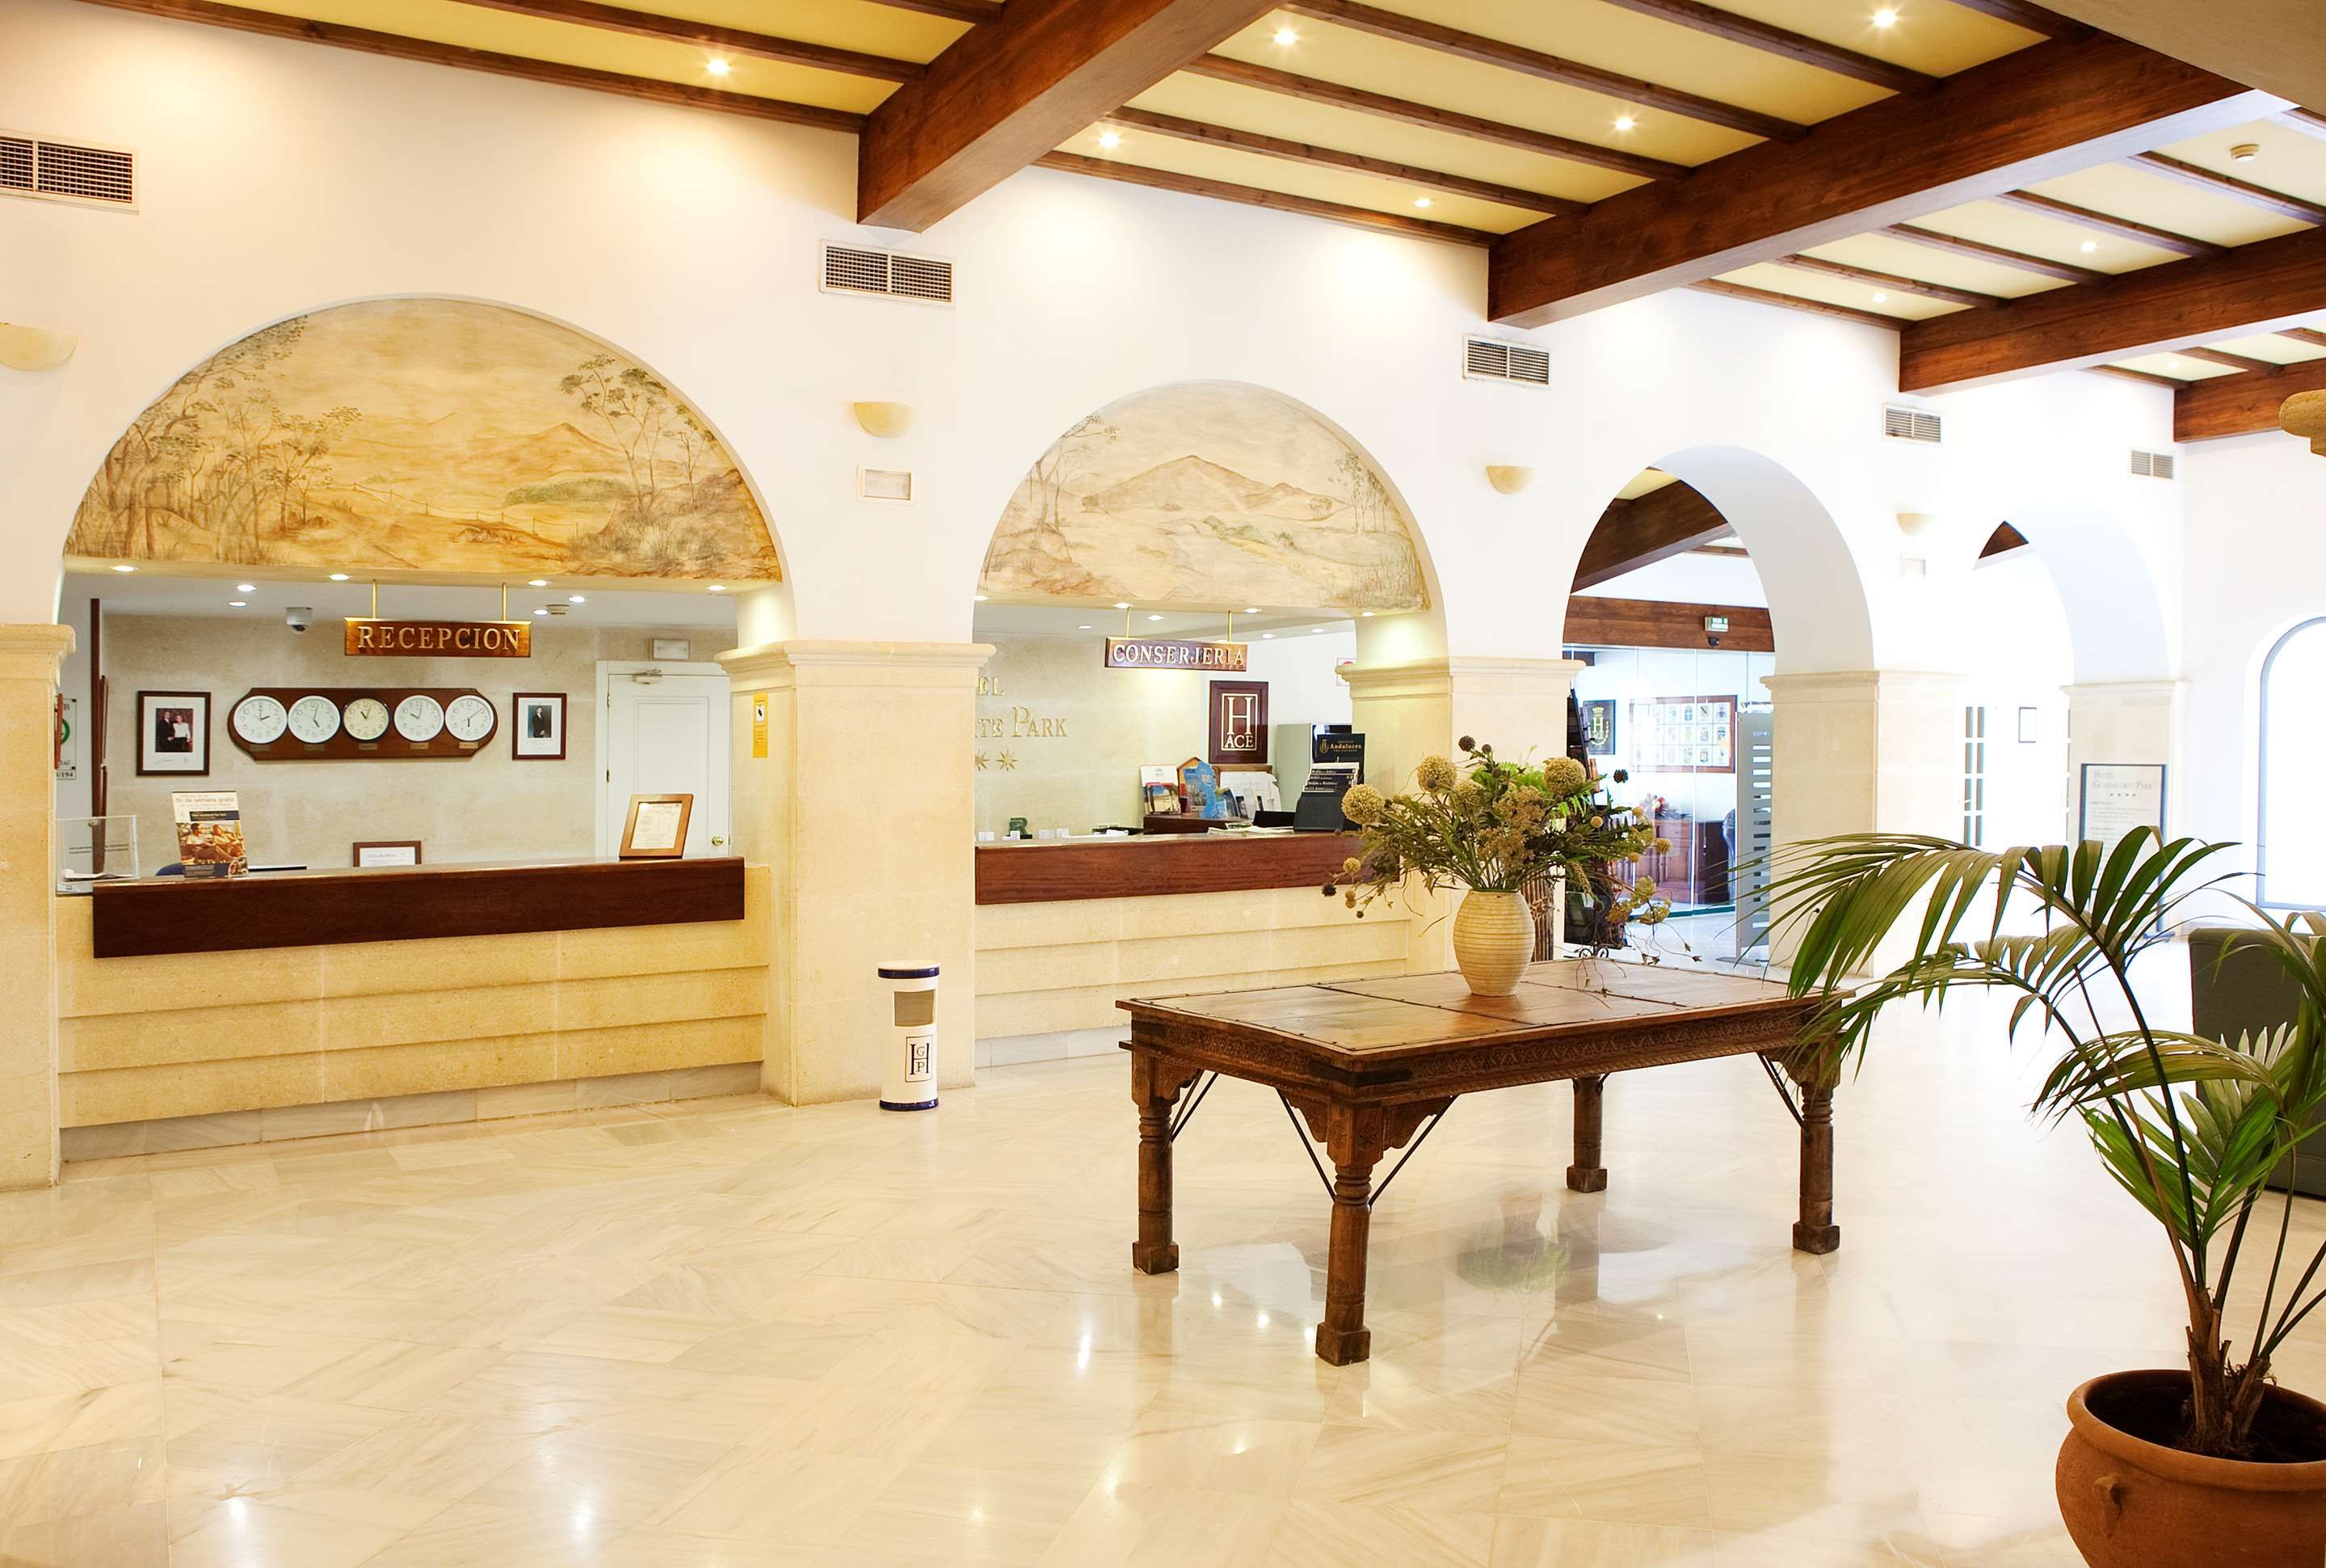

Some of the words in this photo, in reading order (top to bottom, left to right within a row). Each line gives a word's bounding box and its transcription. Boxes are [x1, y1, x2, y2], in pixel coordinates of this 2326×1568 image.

[357, 625, 521, 651] RECEPCION
[1113, 644, 1244, 666] CONSERJERIA
[978, 676, 1004, 696] EL
[1012, 706, 1067, 738] PARK
[1224, 734, 1254, 748] ACE
